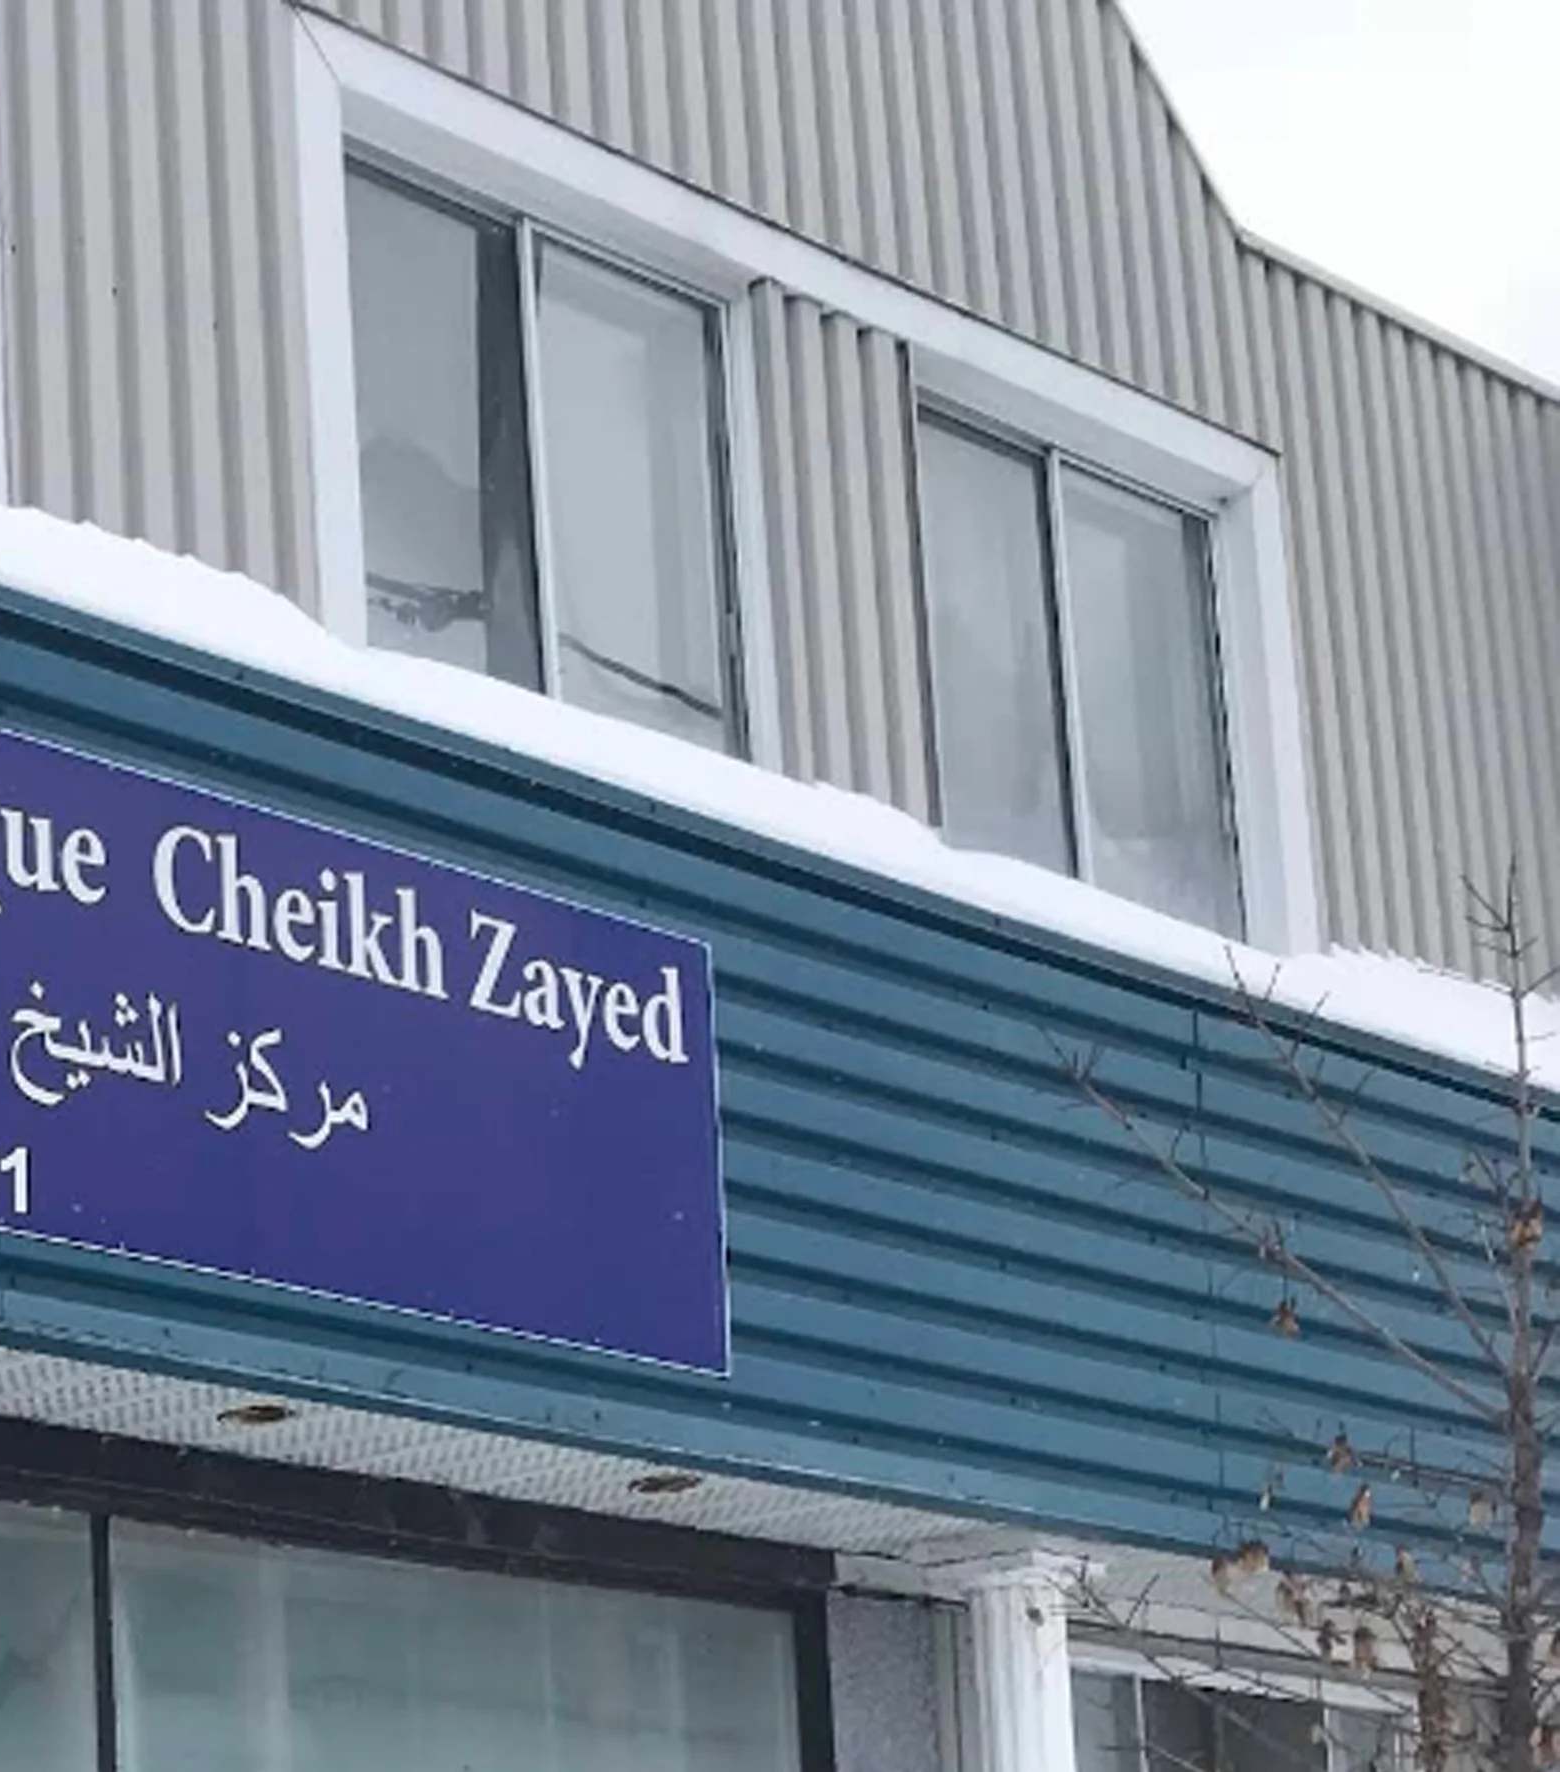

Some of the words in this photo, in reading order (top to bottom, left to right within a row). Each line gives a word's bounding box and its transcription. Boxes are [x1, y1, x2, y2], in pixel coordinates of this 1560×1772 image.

[151, 825, 450, 1001] Cheikh
[467, 908, 691, 1070] Zayed
[9, 980, 183, 1107] الشيخ
[204, 1028, 370, 1150] مركز
